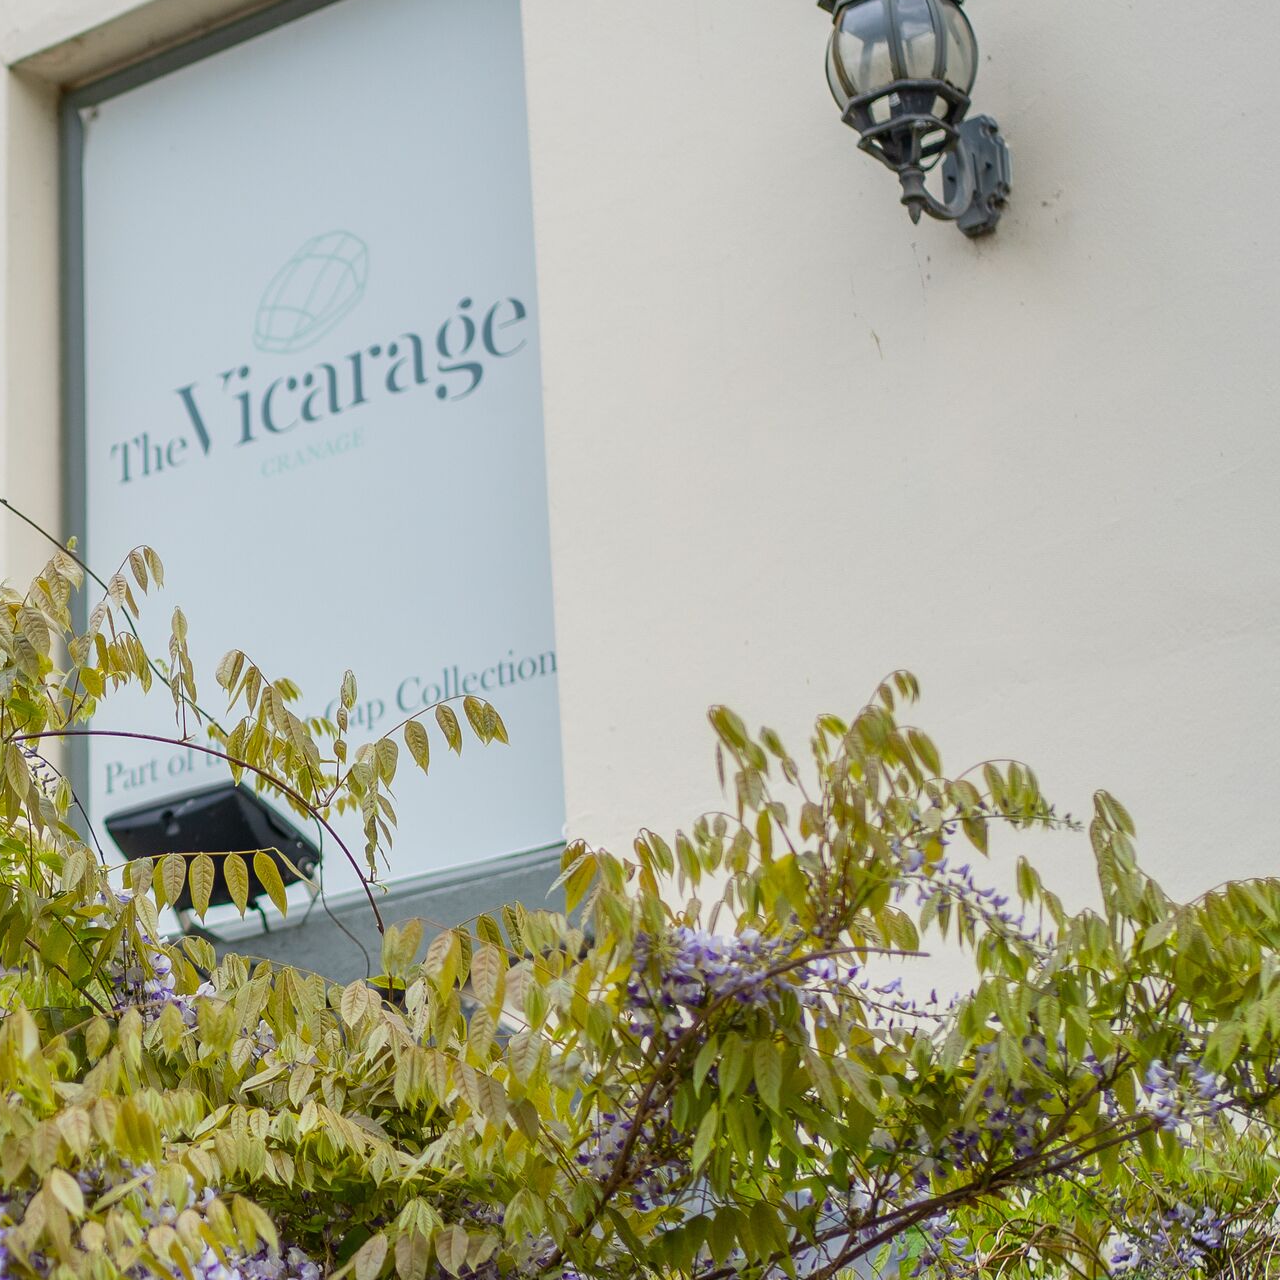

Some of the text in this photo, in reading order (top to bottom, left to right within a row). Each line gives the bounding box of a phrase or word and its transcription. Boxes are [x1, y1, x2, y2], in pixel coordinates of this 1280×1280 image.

[110, 296, 528, 484] The Vicarage
[105, 756, 158, 794] Part
[396, 649, 558, 713] Collection
